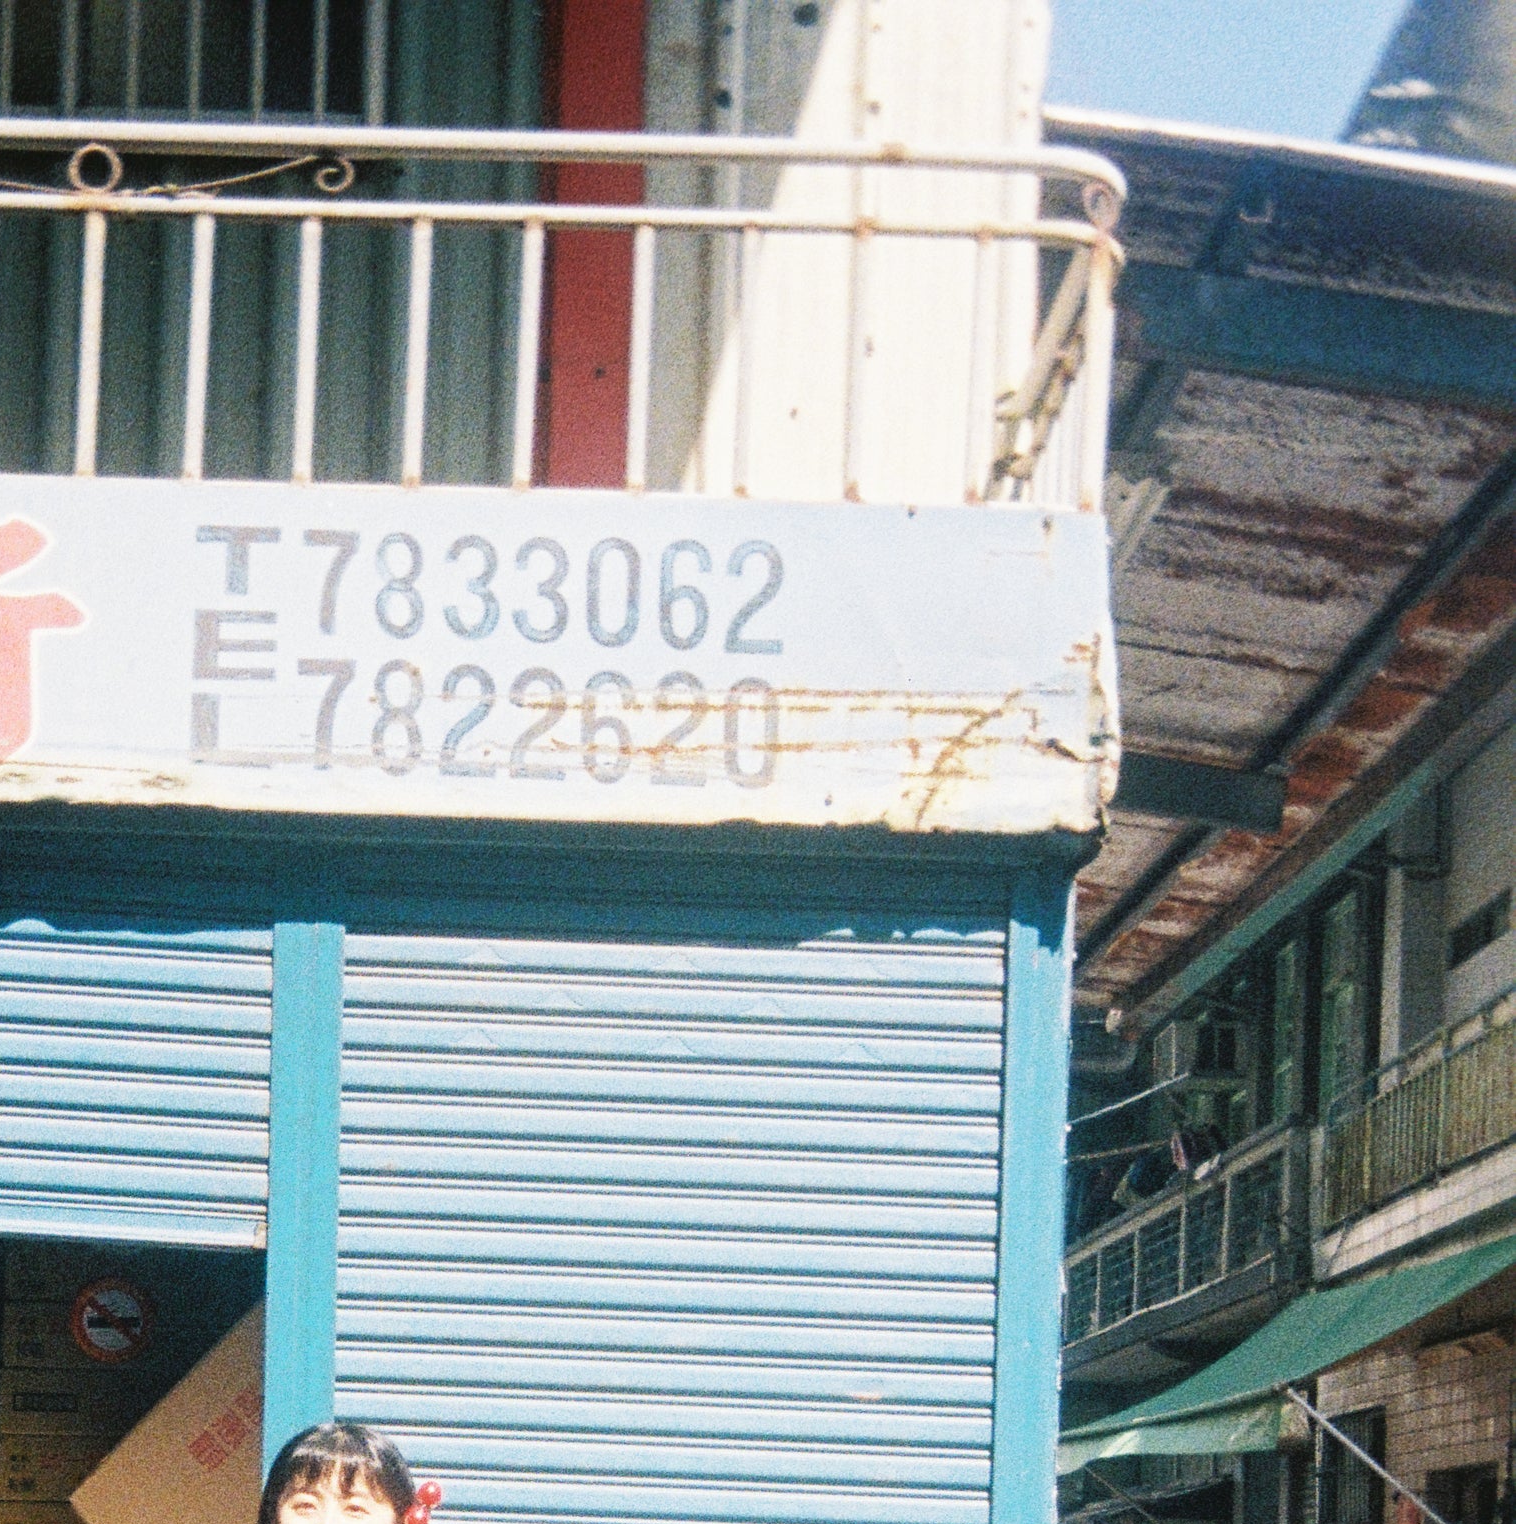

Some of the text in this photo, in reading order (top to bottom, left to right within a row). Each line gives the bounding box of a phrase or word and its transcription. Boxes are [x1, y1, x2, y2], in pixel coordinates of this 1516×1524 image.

[192, 524, 281, 768] TEL
[301, 528, 785, 655] 7833062
[297, 657, 781, 792] 7822620
